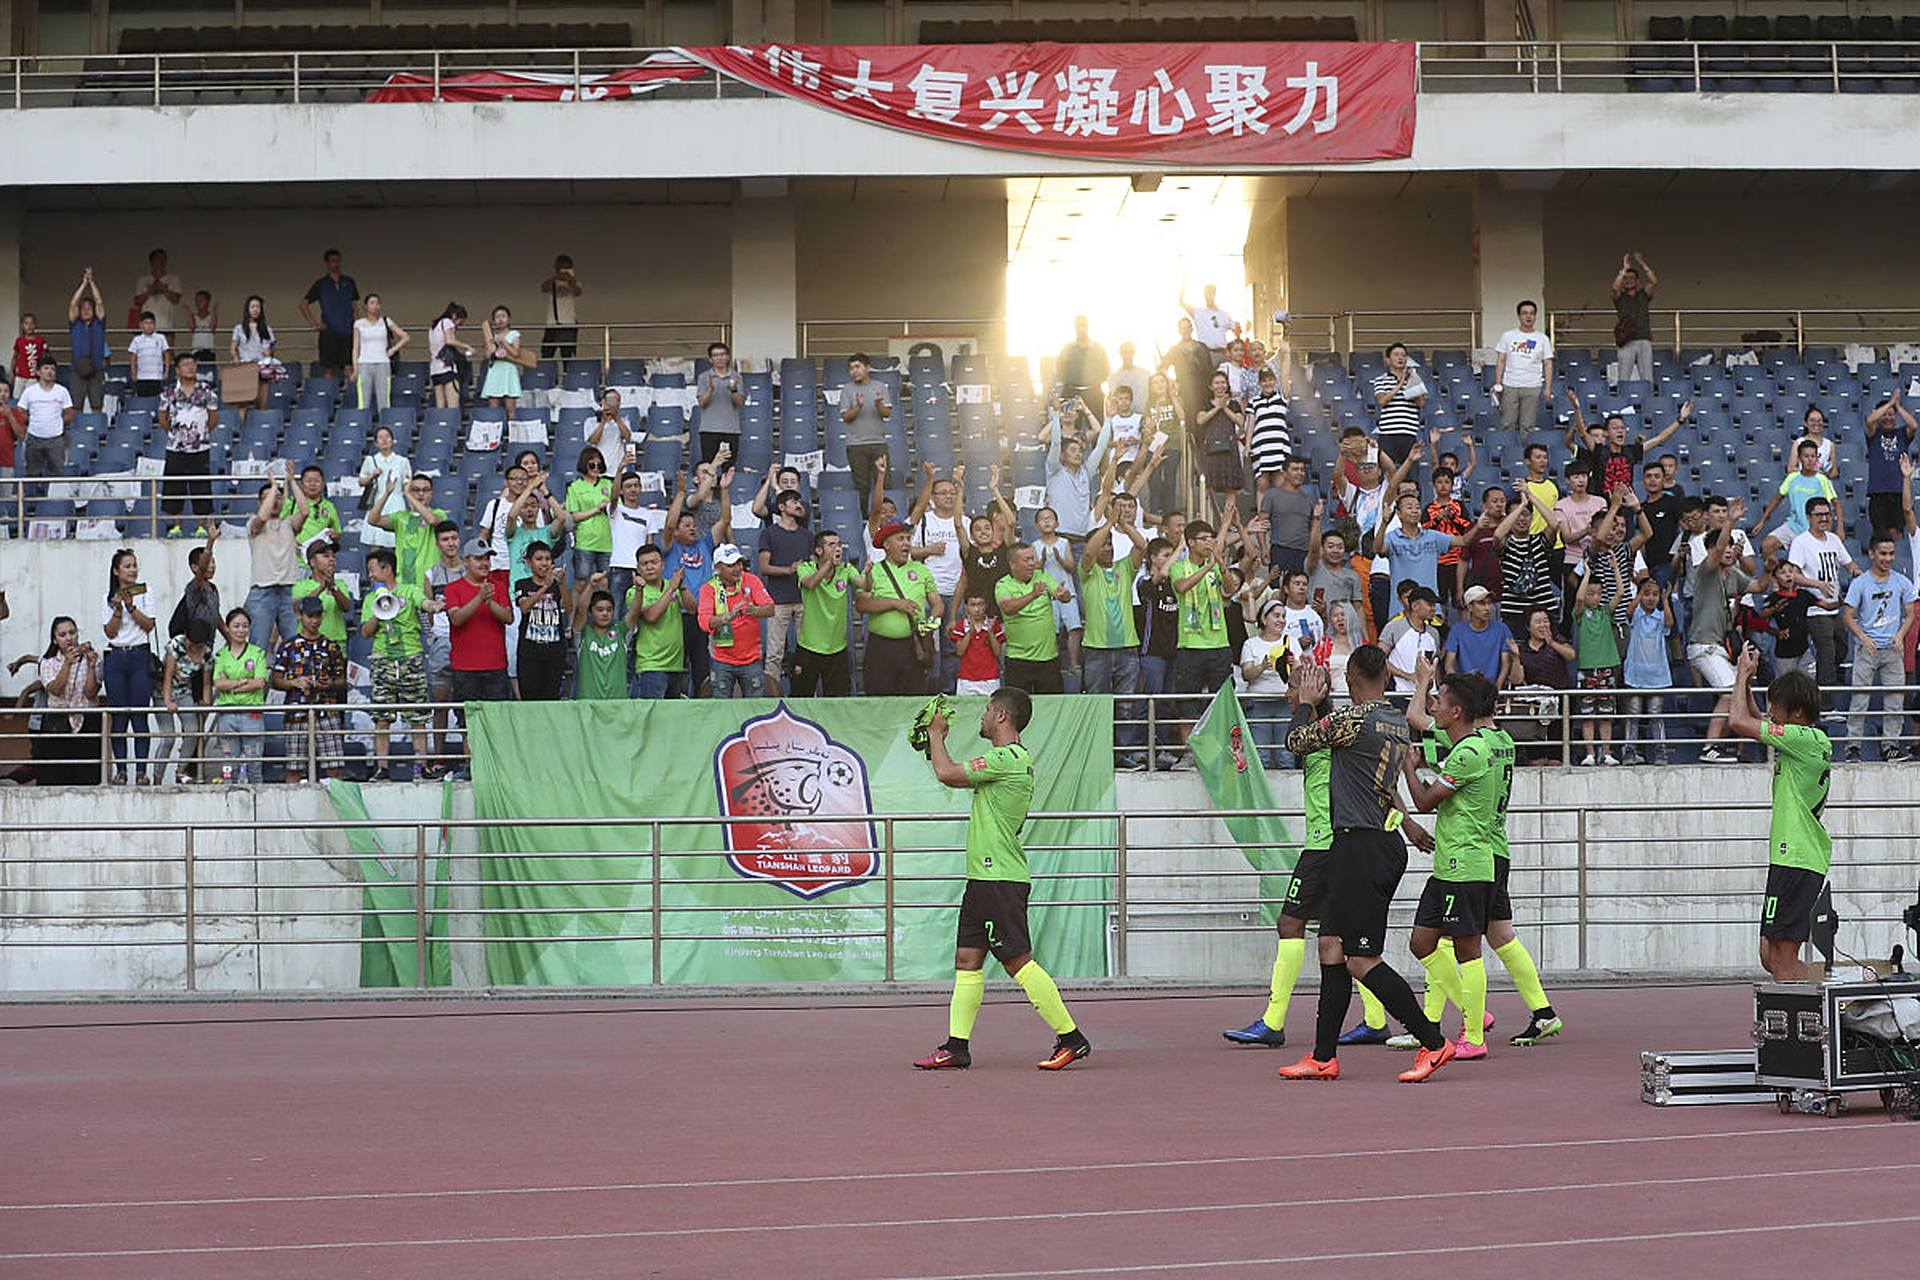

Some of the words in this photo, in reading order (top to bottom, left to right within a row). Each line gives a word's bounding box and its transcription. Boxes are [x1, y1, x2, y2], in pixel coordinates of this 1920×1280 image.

[756, 861, 806, 872] TIANSHAN
[807, 865, 852, 873] LEOPARD
[1289, 878, 1301, 898] 6
[1445, 895, 1455, 916] 7
[1765, 895, 1779, 919] 0
[985, 921, 996, 942] 2
